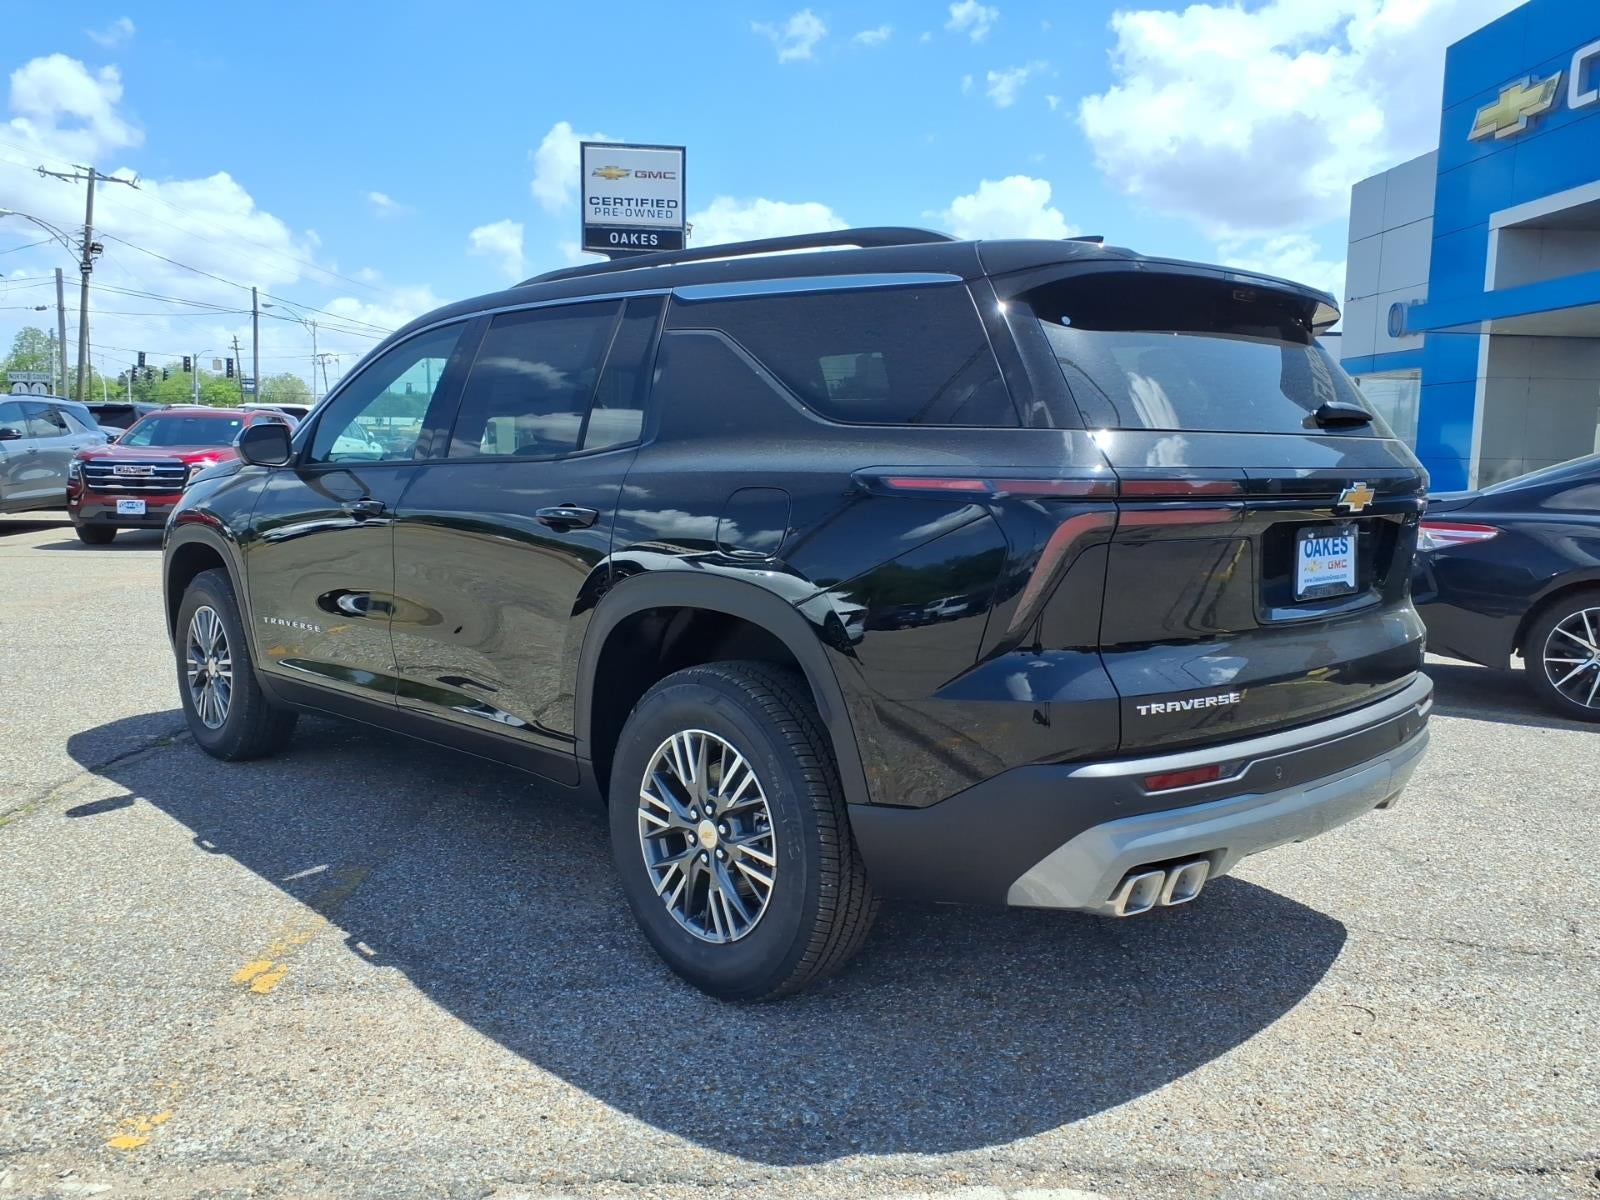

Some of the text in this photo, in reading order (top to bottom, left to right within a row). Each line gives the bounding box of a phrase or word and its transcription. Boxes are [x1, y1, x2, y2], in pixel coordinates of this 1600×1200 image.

[634, 170, 677, 180] GMC
[589, 196, 678, 209] CERTIFIED
[594, 207, 673, 219] PRE-OWNED
[609, 232, 658, 246] OAKES
[1304, 537, 1348, 558] OAKES
[1327, 559, 1348, 570] GMC
[263, 616, 321, 633] TRAVERSE
[1136, 692, 1241, 716] TRAVERSE
